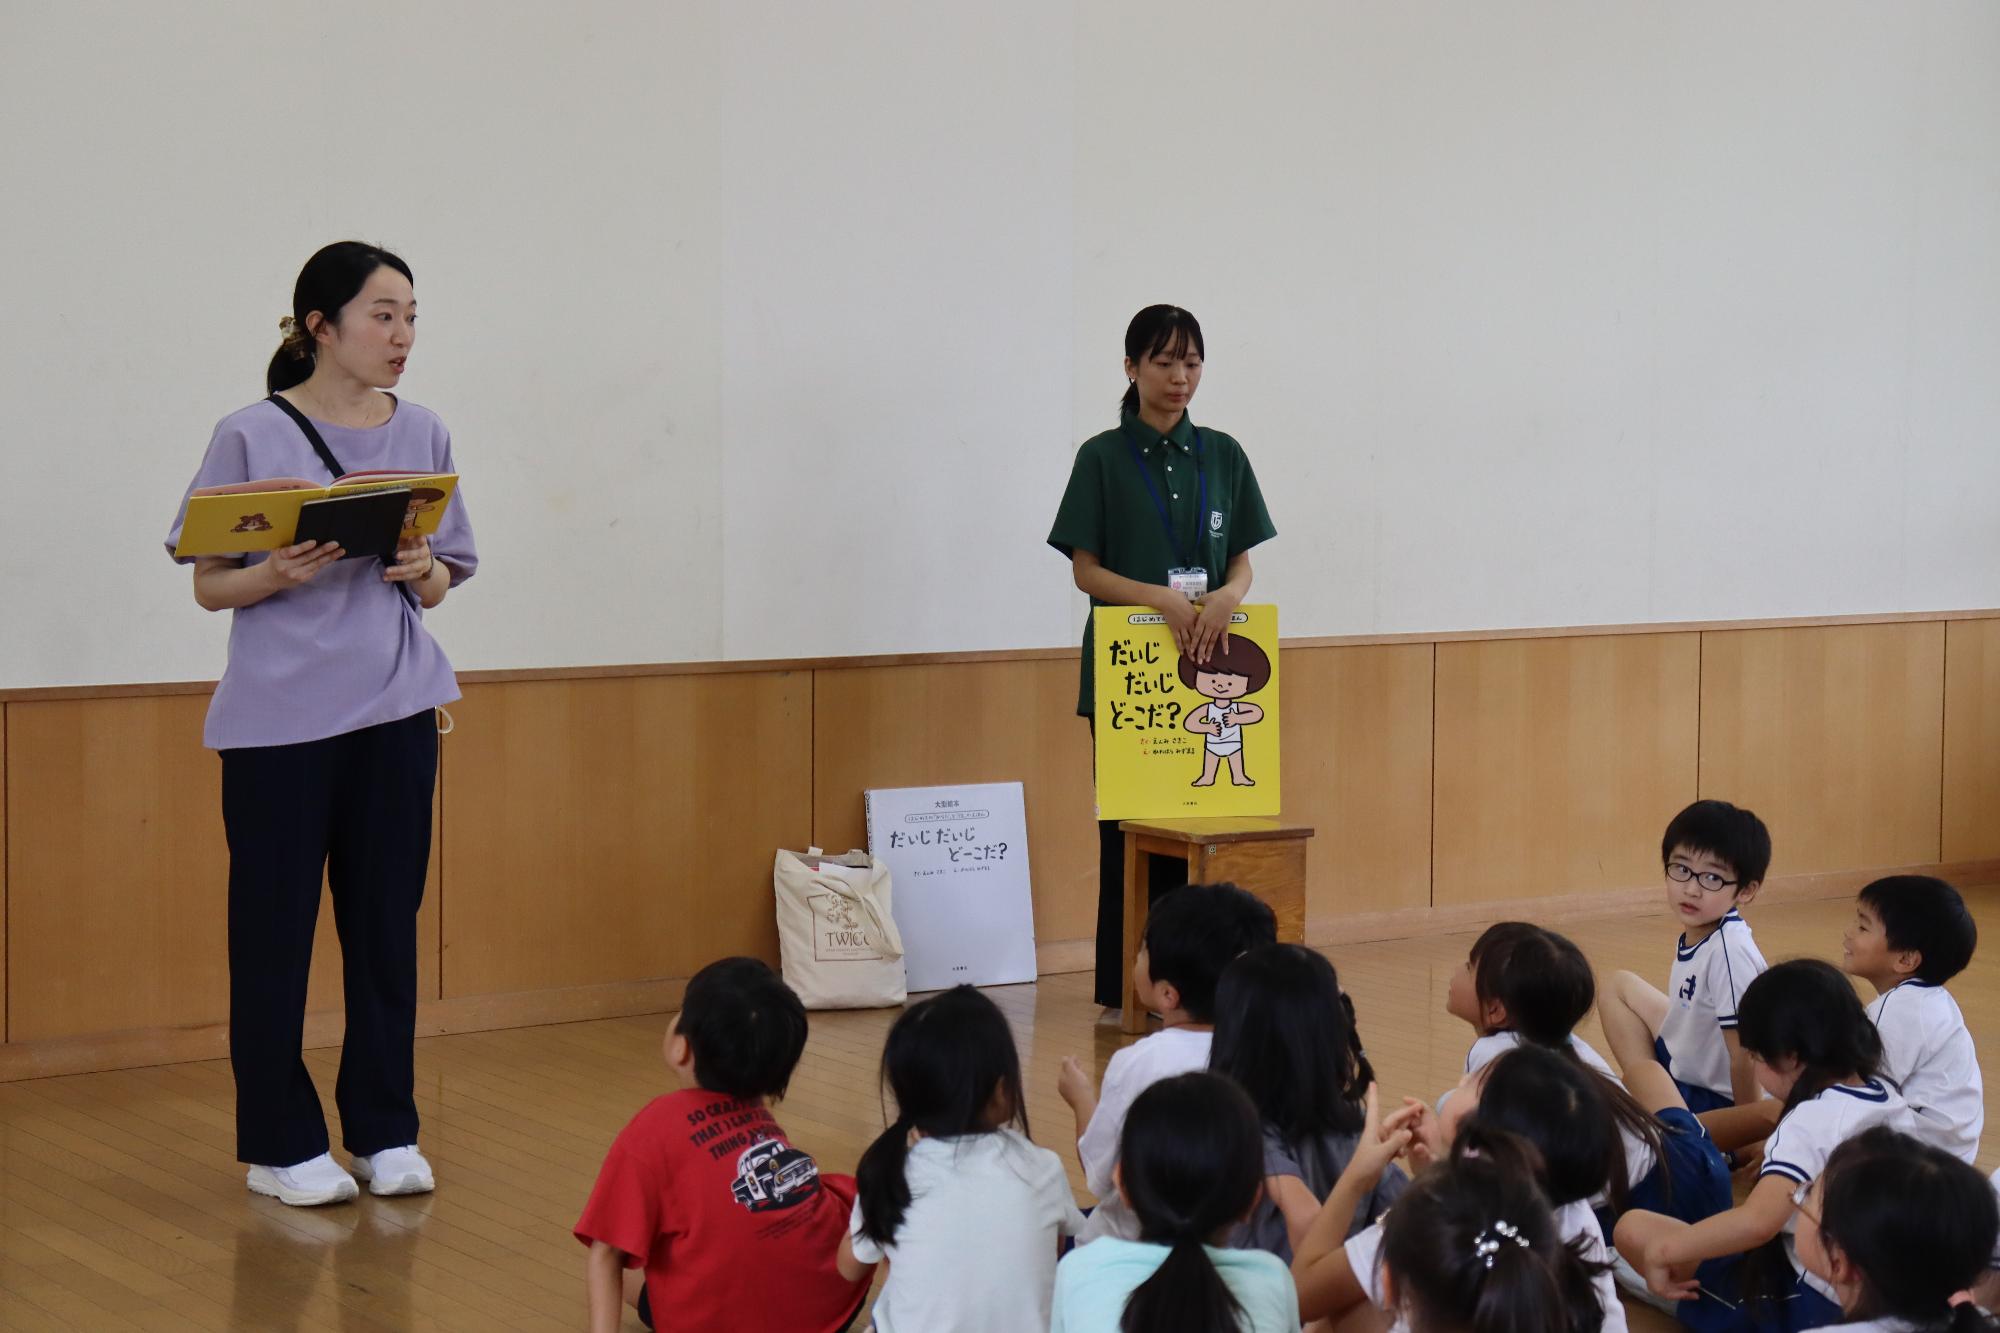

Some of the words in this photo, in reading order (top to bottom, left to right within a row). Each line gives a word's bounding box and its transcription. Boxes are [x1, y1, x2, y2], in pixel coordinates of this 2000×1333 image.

[1109, 639, 1160, 666] だいじ
[1124, 671, 1175, 695] だいじ
[1110, 700, 1182, 730] どーこだ?
[890, 830, 931, 848] だいじ
[936, 826, 976, 844] だいじ
[949, 842, 1008, 862] どーこだ?
[687, 1109, 706, 1126] SO
[690, 1121, 722, 1147] THAT
